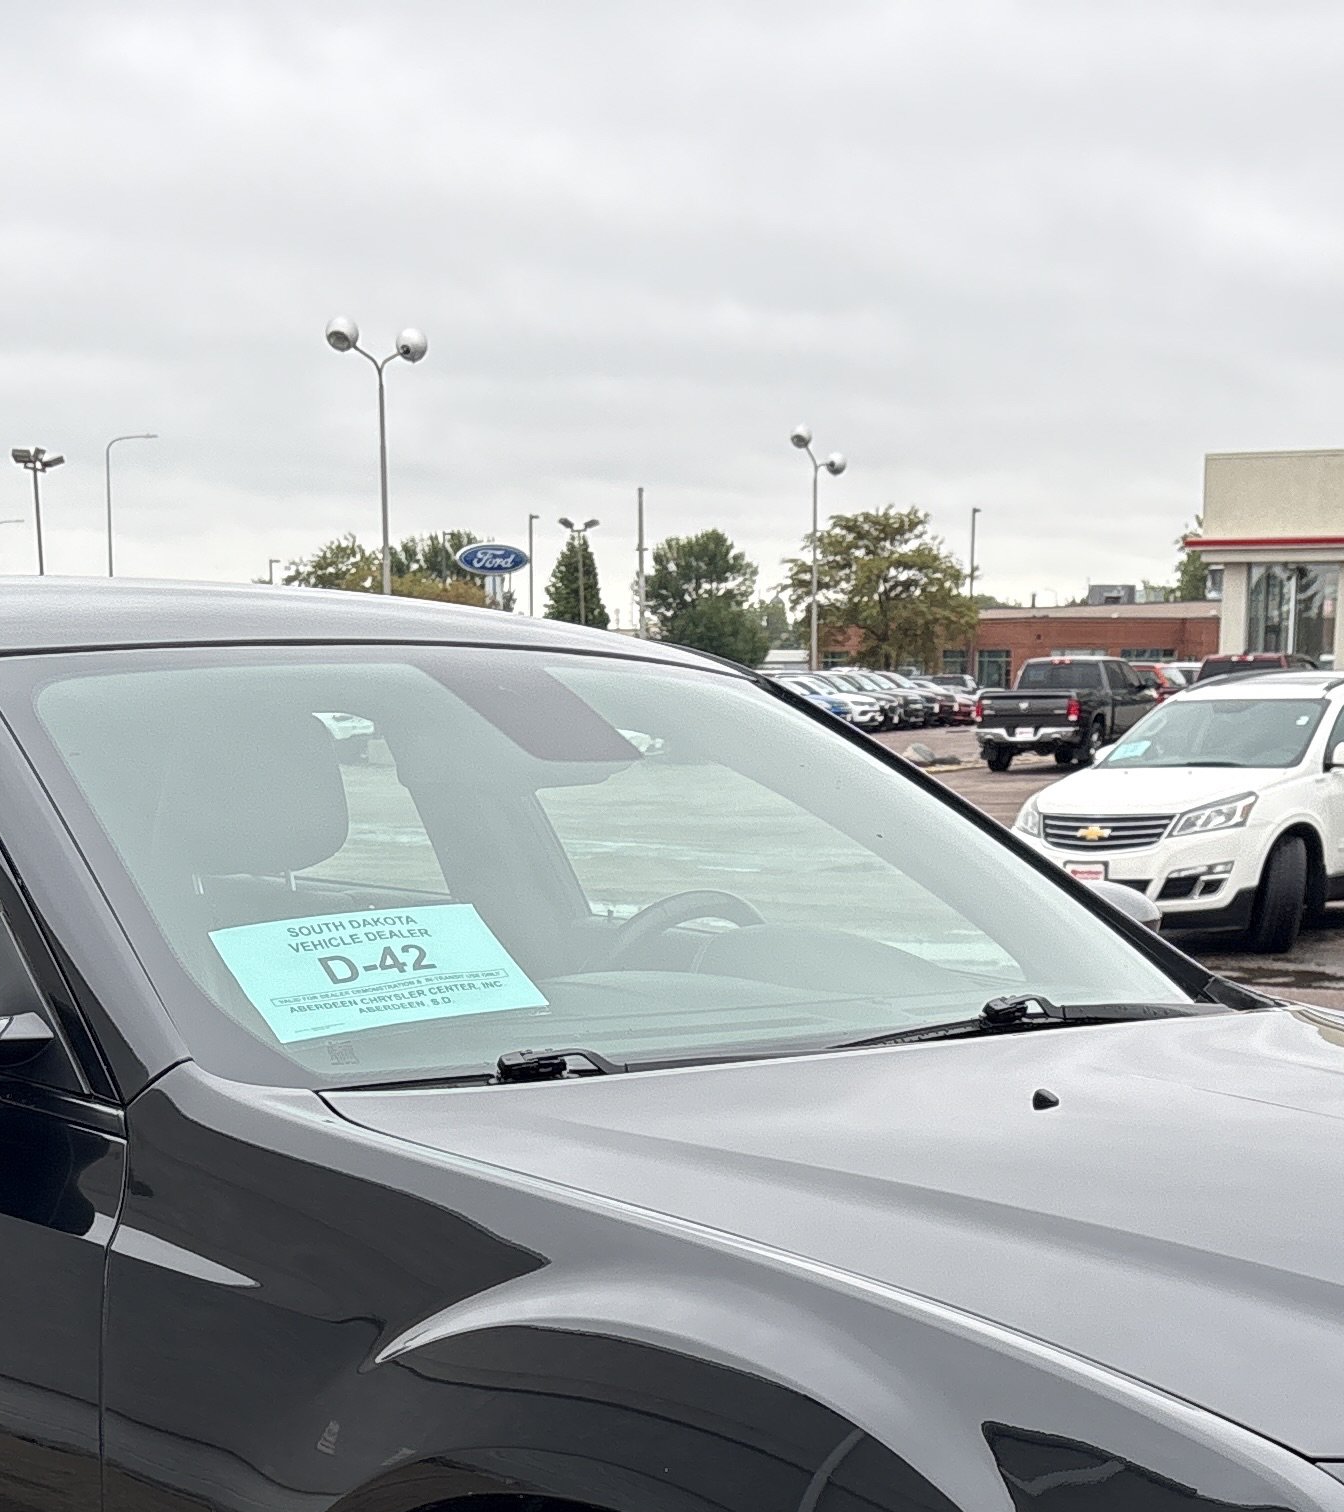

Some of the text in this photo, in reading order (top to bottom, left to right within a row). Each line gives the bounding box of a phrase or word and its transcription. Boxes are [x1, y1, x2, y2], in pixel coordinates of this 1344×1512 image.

[472, 549, 516, 569] Ford
[286, 914, 418, 938] SOUTH DAKOTA
[287, 927, 433, 954] VEHICLE DEALER
[317, 944, 438, 985] D-42
[290, 999, 359, 1014] ABERDEEN
[360, 989, 428, 1005] CHRYSLER
